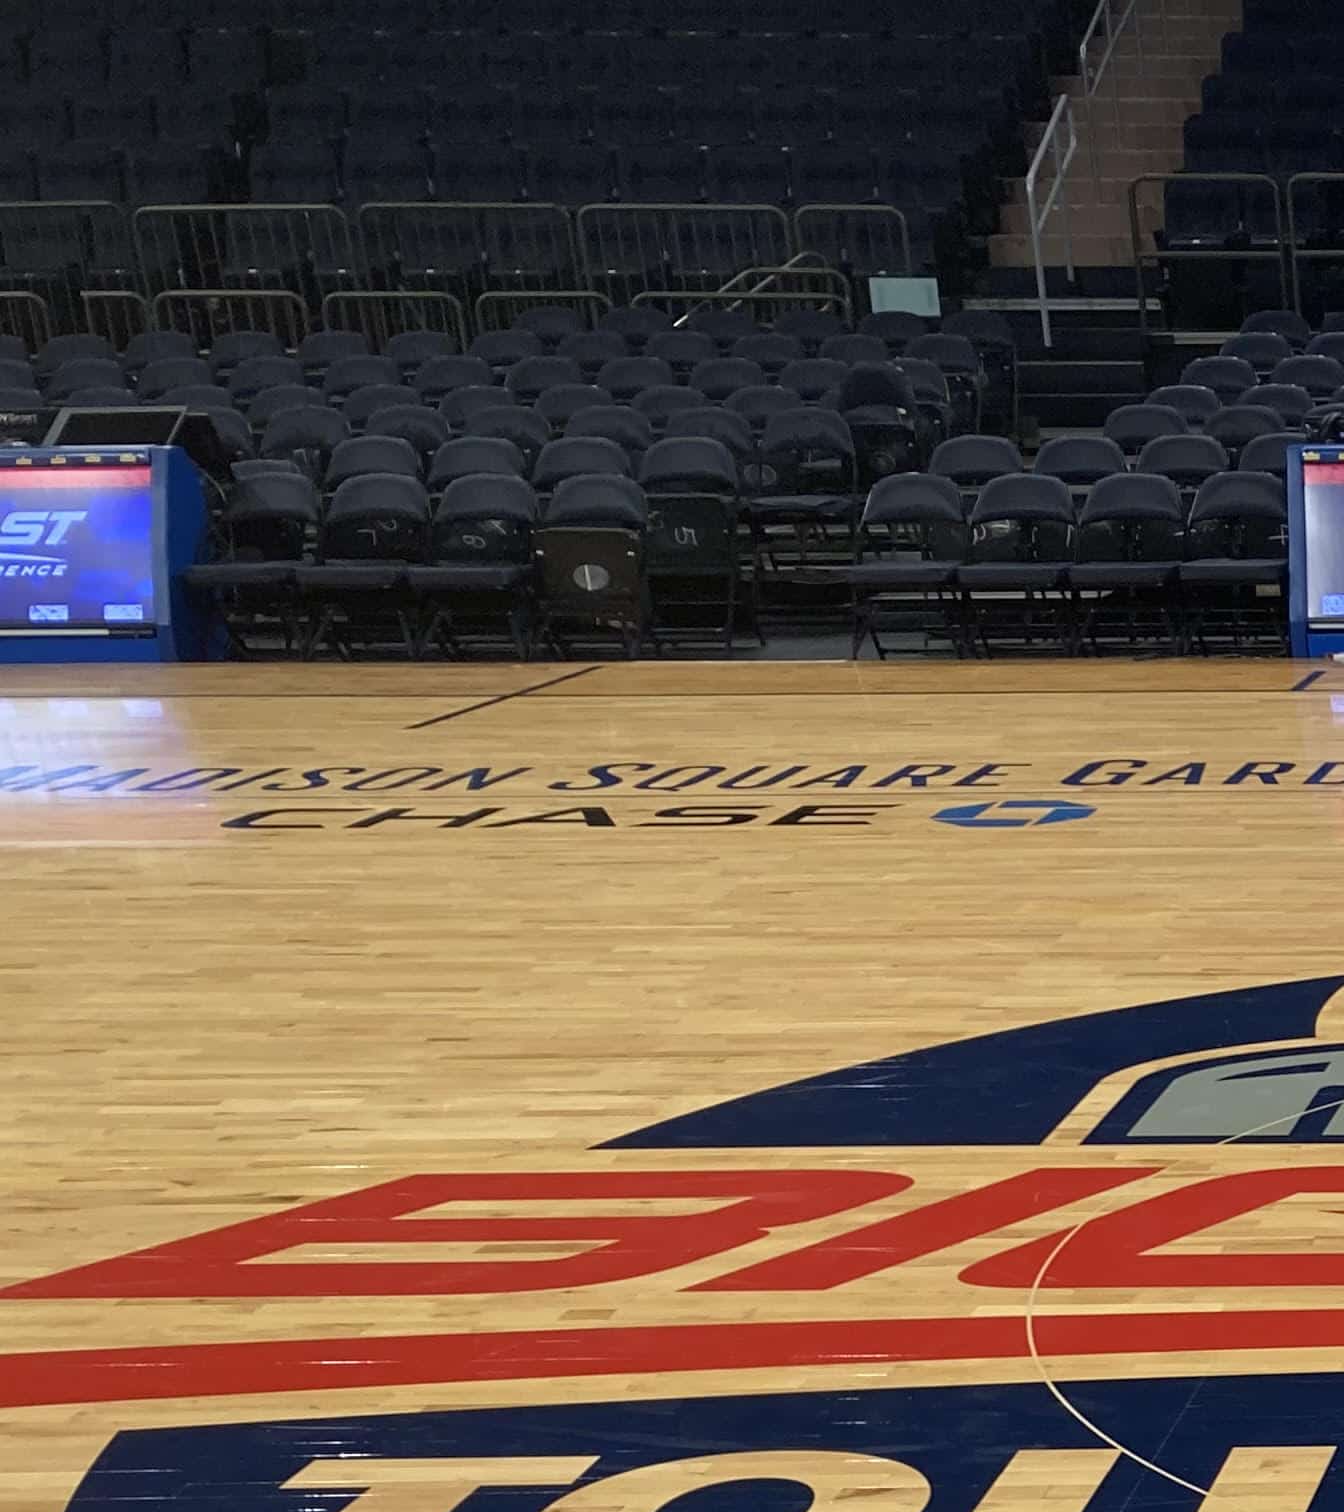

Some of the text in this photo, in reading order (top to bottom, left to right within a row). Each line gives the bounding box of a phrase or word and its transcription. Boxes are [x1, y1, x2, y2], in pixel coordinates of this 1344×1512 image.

[0, 765, 533, 793] MADISON
[548, 762, 1033, 792] SQUARE
[220, 804, 902, 829] CHASE
